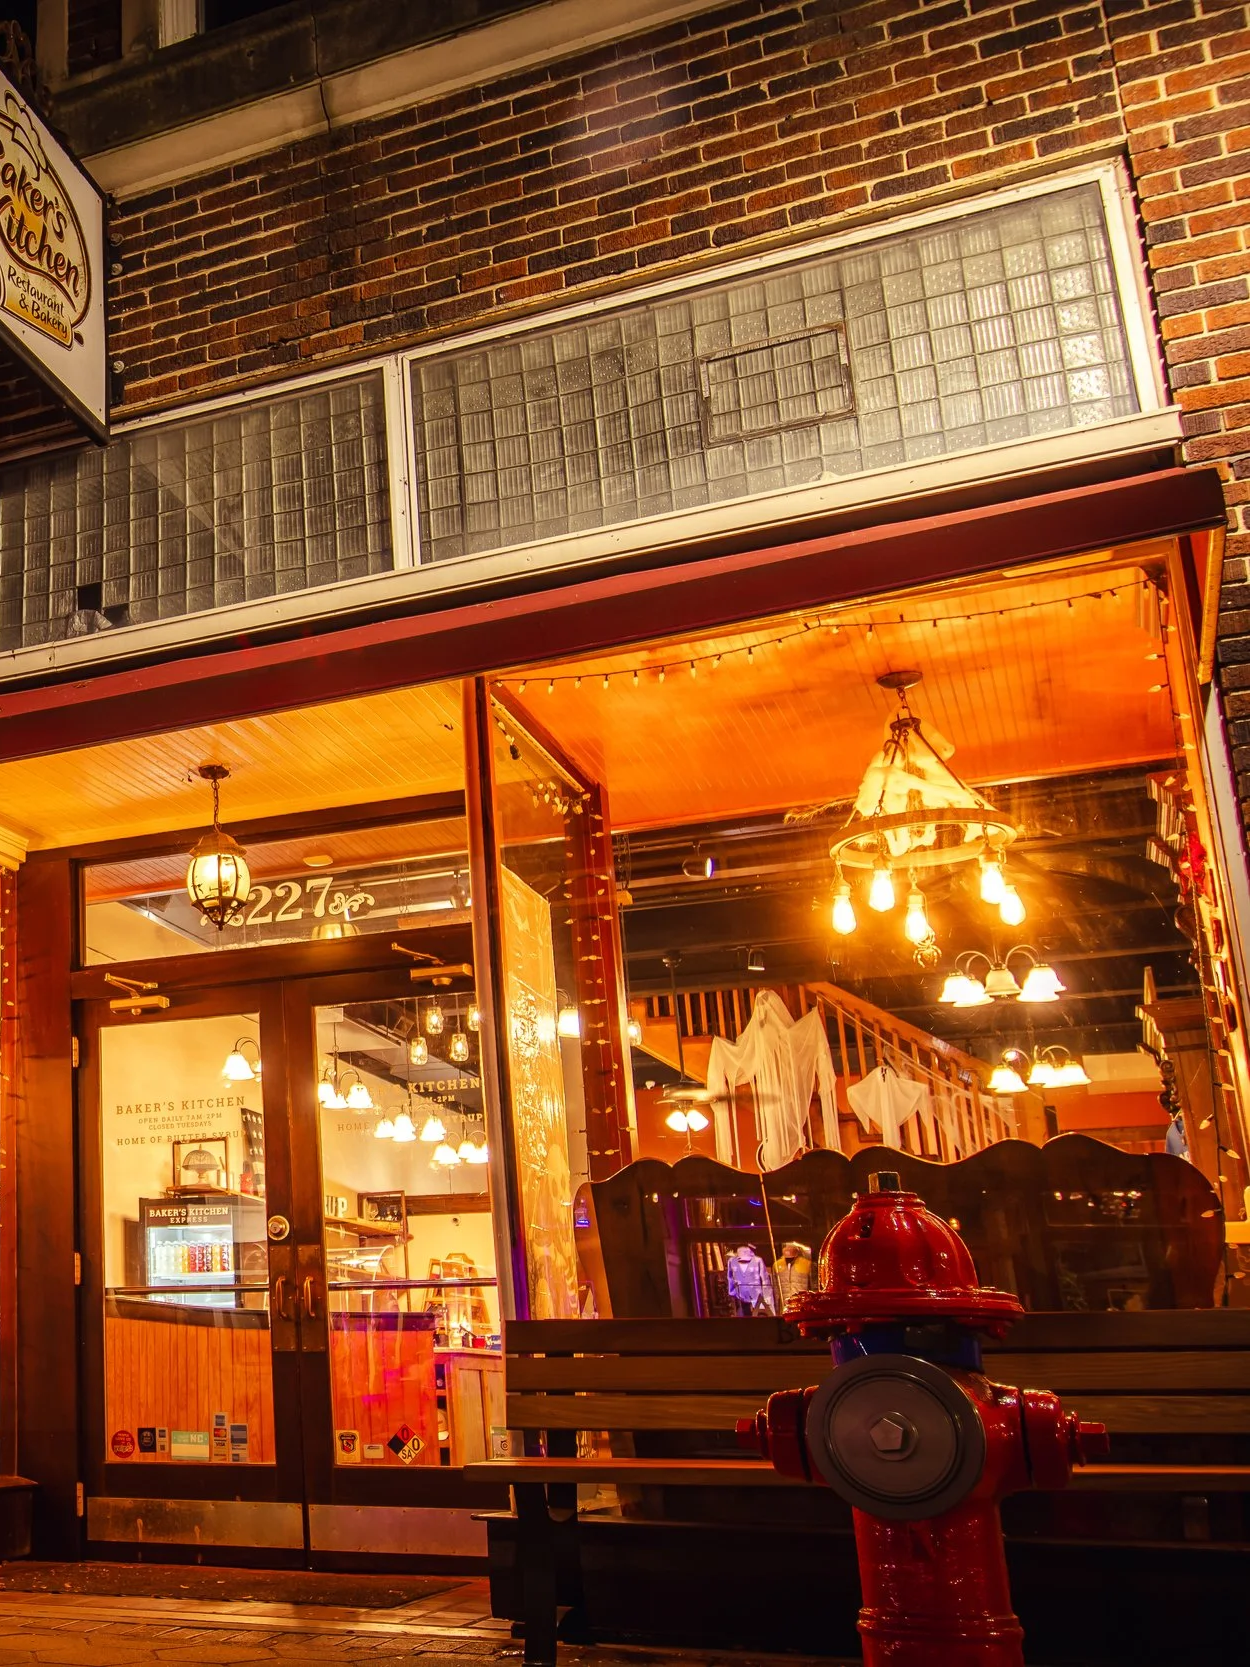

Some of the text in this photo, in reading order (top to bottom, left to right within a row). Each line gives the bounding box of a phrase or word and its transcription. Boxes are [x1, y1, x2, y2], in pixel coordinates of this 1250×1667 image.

[7, 264, 64, 318] Restaurant
[18, 293, 69, 340] & Bakery
[246, 877, 334, 926] 227
[408, 1077, 481, 1093] KITCHEN
[116, 1096, 245, 1115] BAKER'S KITCHEN
[161, 1115, 183, 1123] DAILY
[148, 1120, 212, 1131] CLOSED TUESDAYS
[117, 1137, 146, 1146] HOME
[150, 1135, 162, 1143] OF
[149, 1206, 229, 1217] BAKER'S KITCHEN
[170, 1216, 208, 1224] EXPRESS
[190, 1434, 204, 1443] NC
[401, 1427, 410, 1441] 0
[411, 1438, 420, 1451] 0
[401, 1450, 413, 1460] SA
